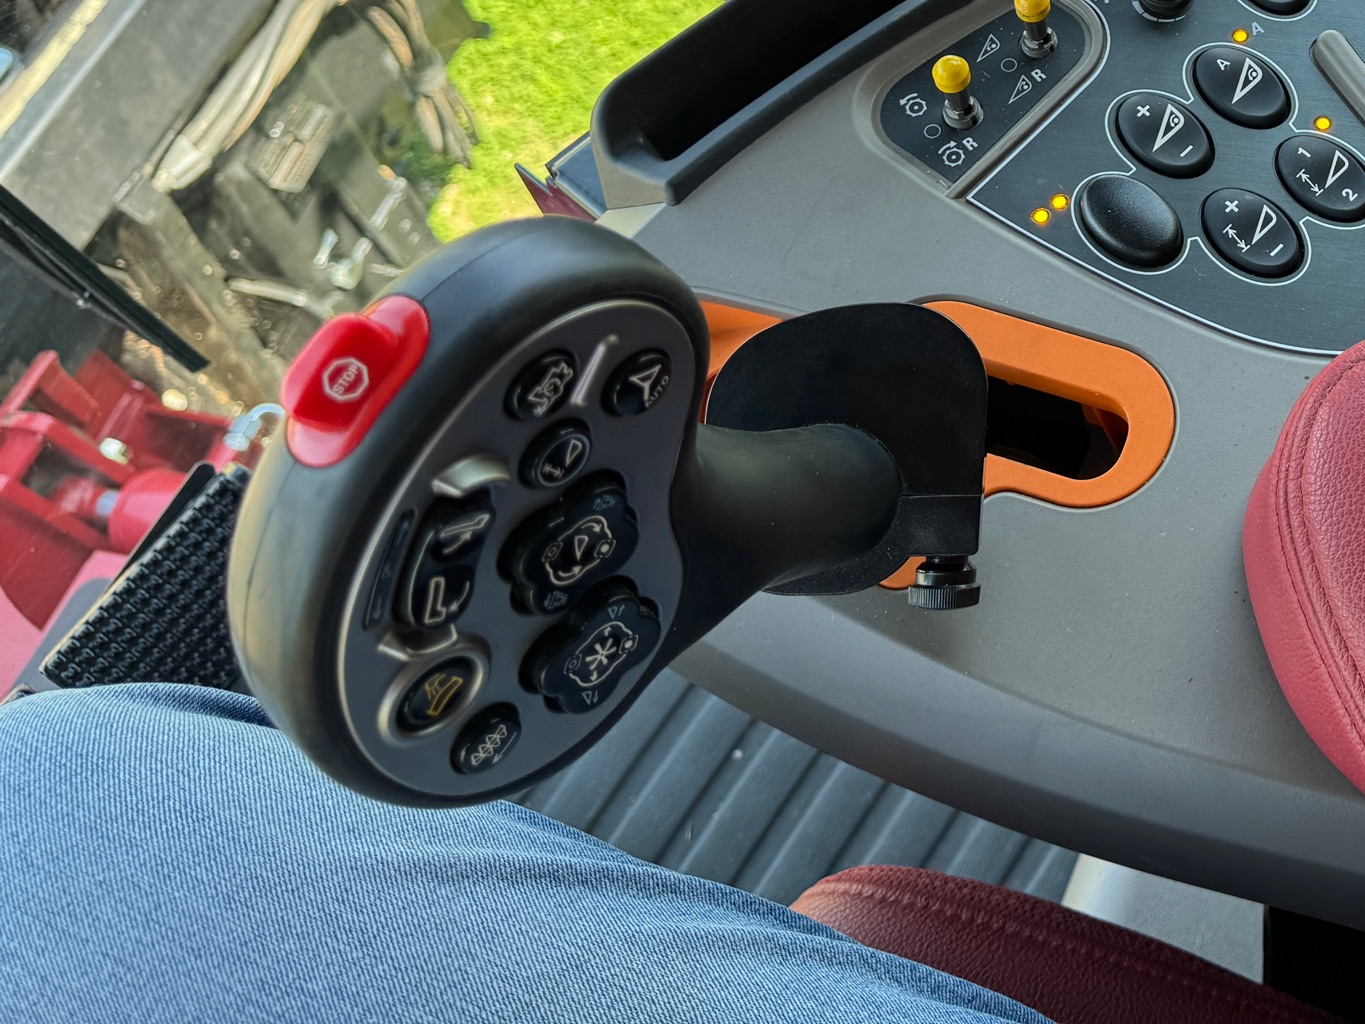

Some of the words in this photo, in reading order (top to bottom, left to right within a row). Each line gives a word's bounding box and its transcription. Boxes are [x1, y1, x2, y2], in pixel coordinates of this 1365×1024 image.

[1251, 22, 1265, 36] A
[1216, 58, 1231, 71] A
[1031, 68, 1047, 83] R
[962, 136, 978, 151] R
[1341, 188, 1359, 203] 2
[333, 365, 358, 394] STOP
[645, 376, 669, 408] AUTO
